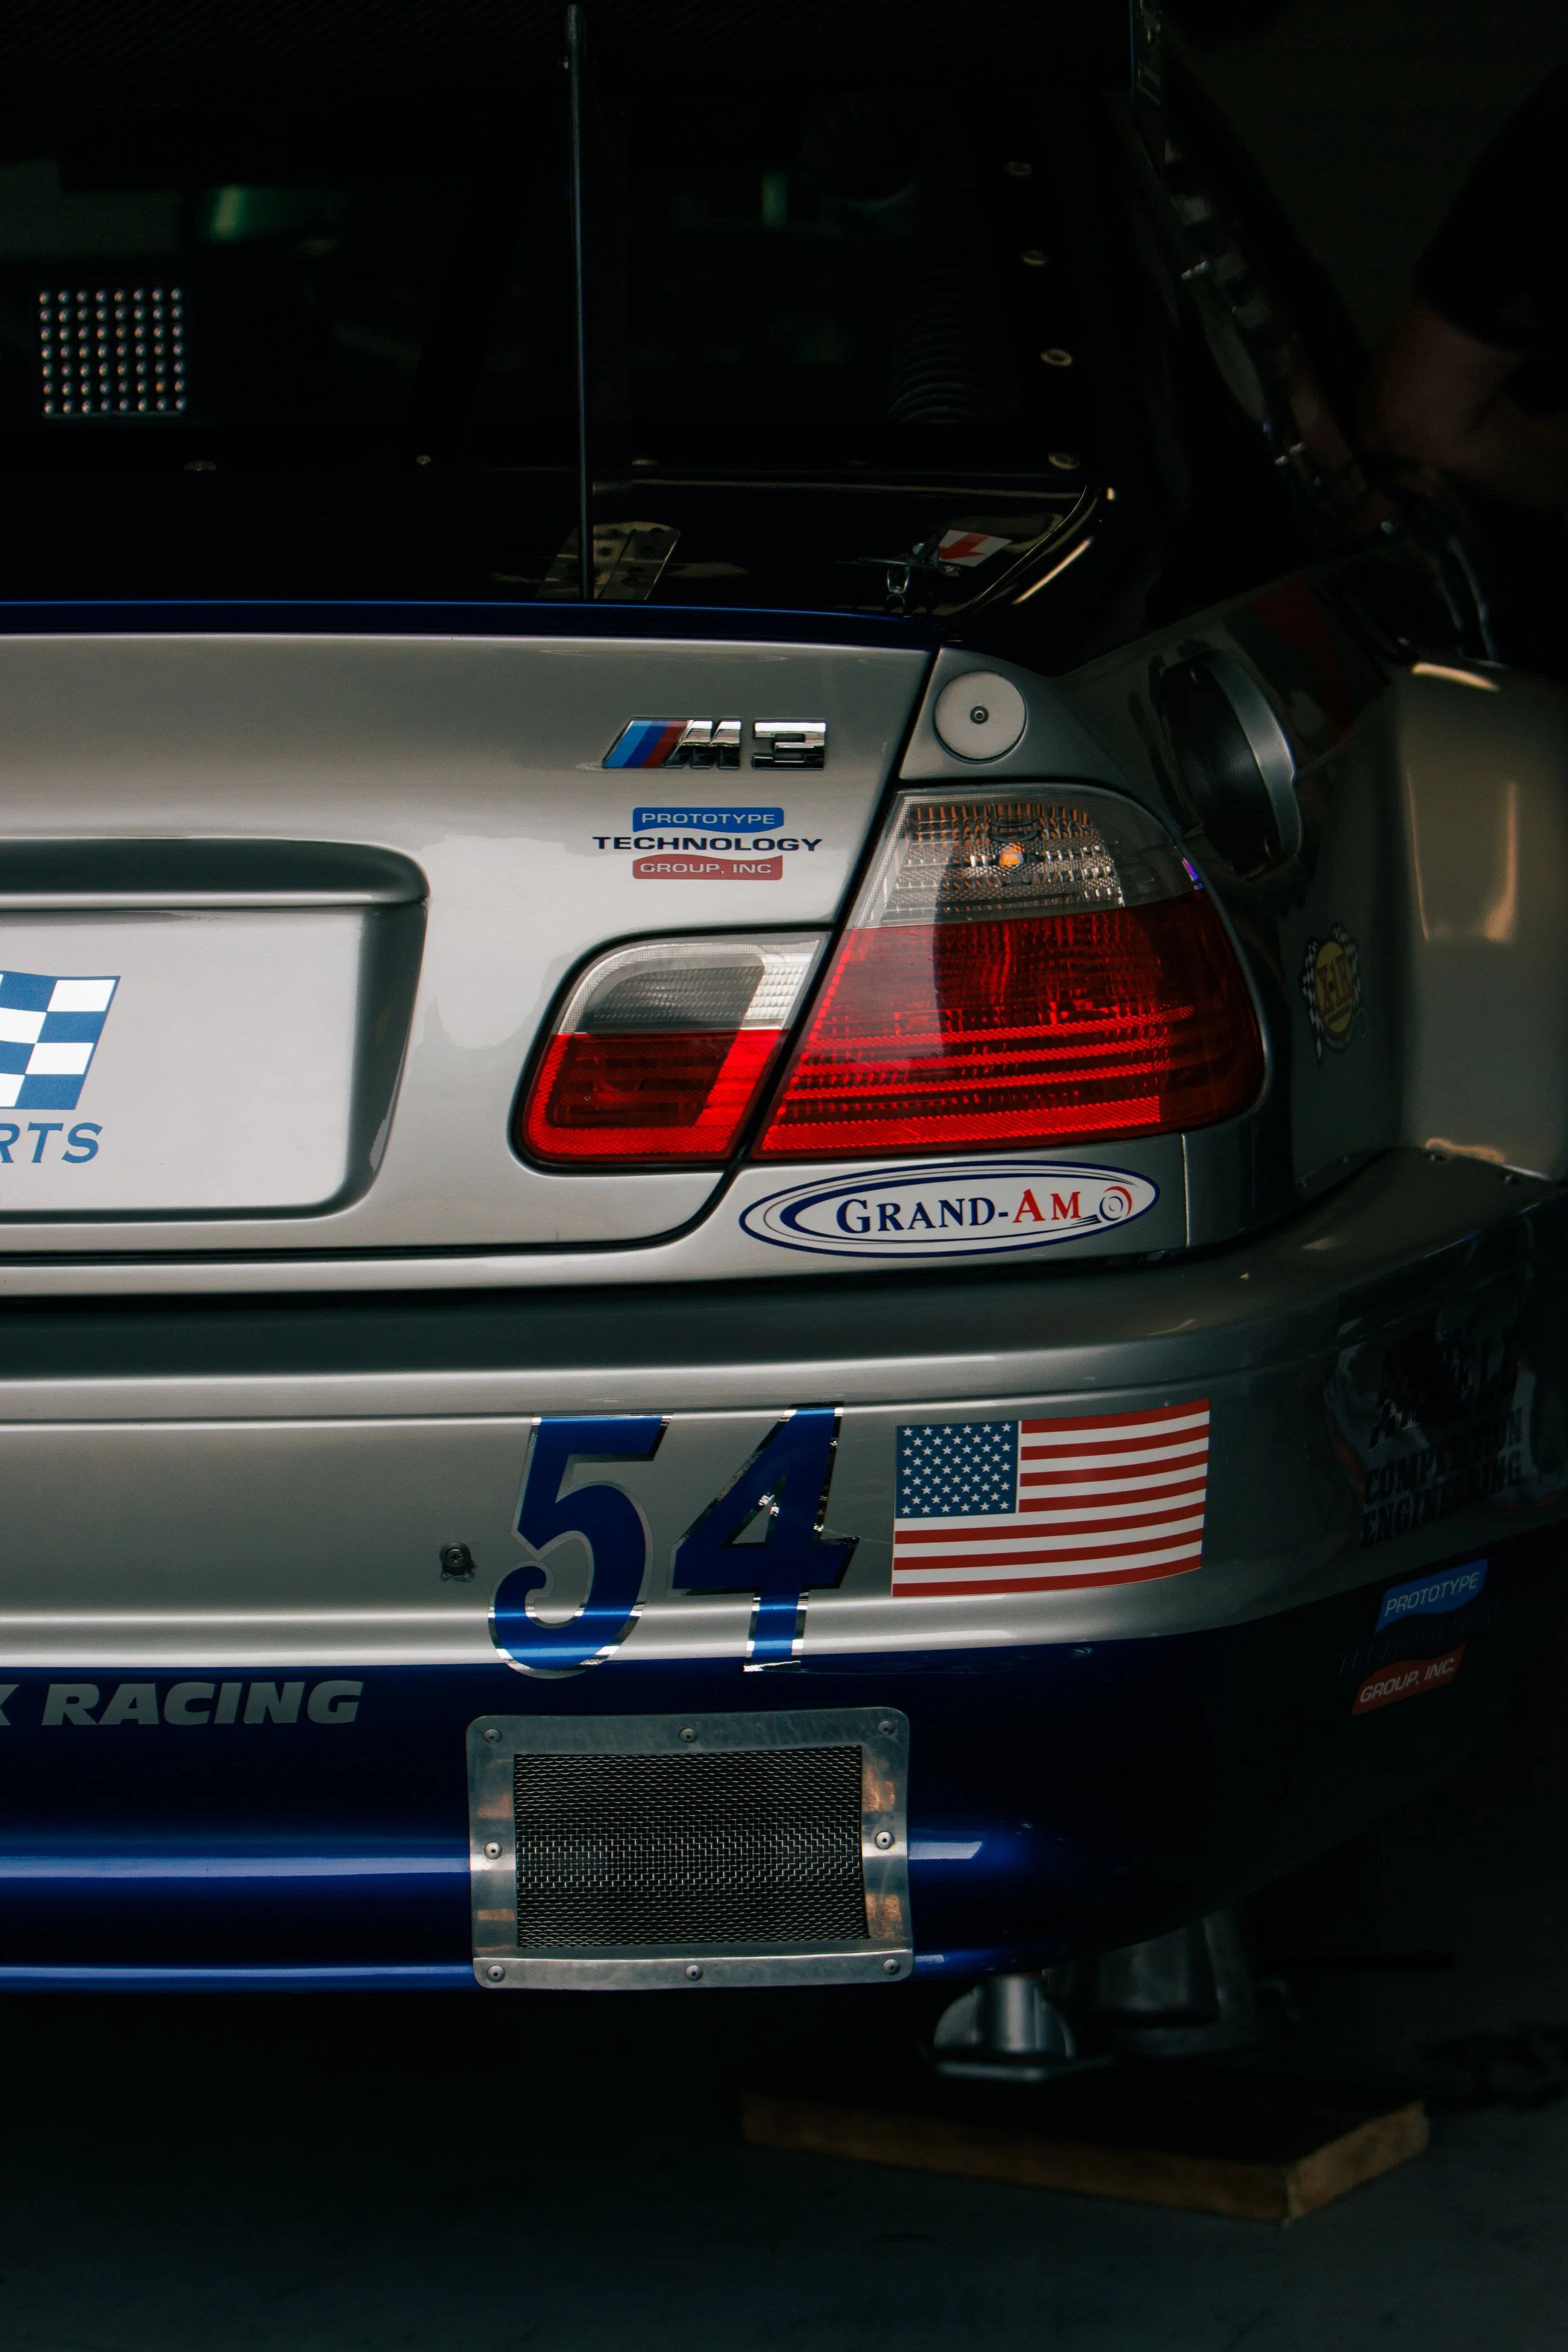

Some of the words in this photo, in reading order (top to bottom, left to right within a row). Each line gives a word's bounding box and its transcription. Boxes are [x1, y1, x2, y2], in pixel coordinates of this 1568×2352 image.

[662, 717, 827, 770] M3
[641, 813, 775, 825] PROTOTYPE
[592, 836, 823, 852] TECHNOLOGY
[639, 863, 724, 875] GROUP,
[733, 863, 772, 874] INC
[487, 1401, 861, 1679] 54
[1384, 1571, 1480, 1617] PROTOTYPE
[41, 1680, 364, 1726] RACING
[1359, 1670, 1421, 1703] GROUP,
[1424, 1657, 1455, 1681] INC.
